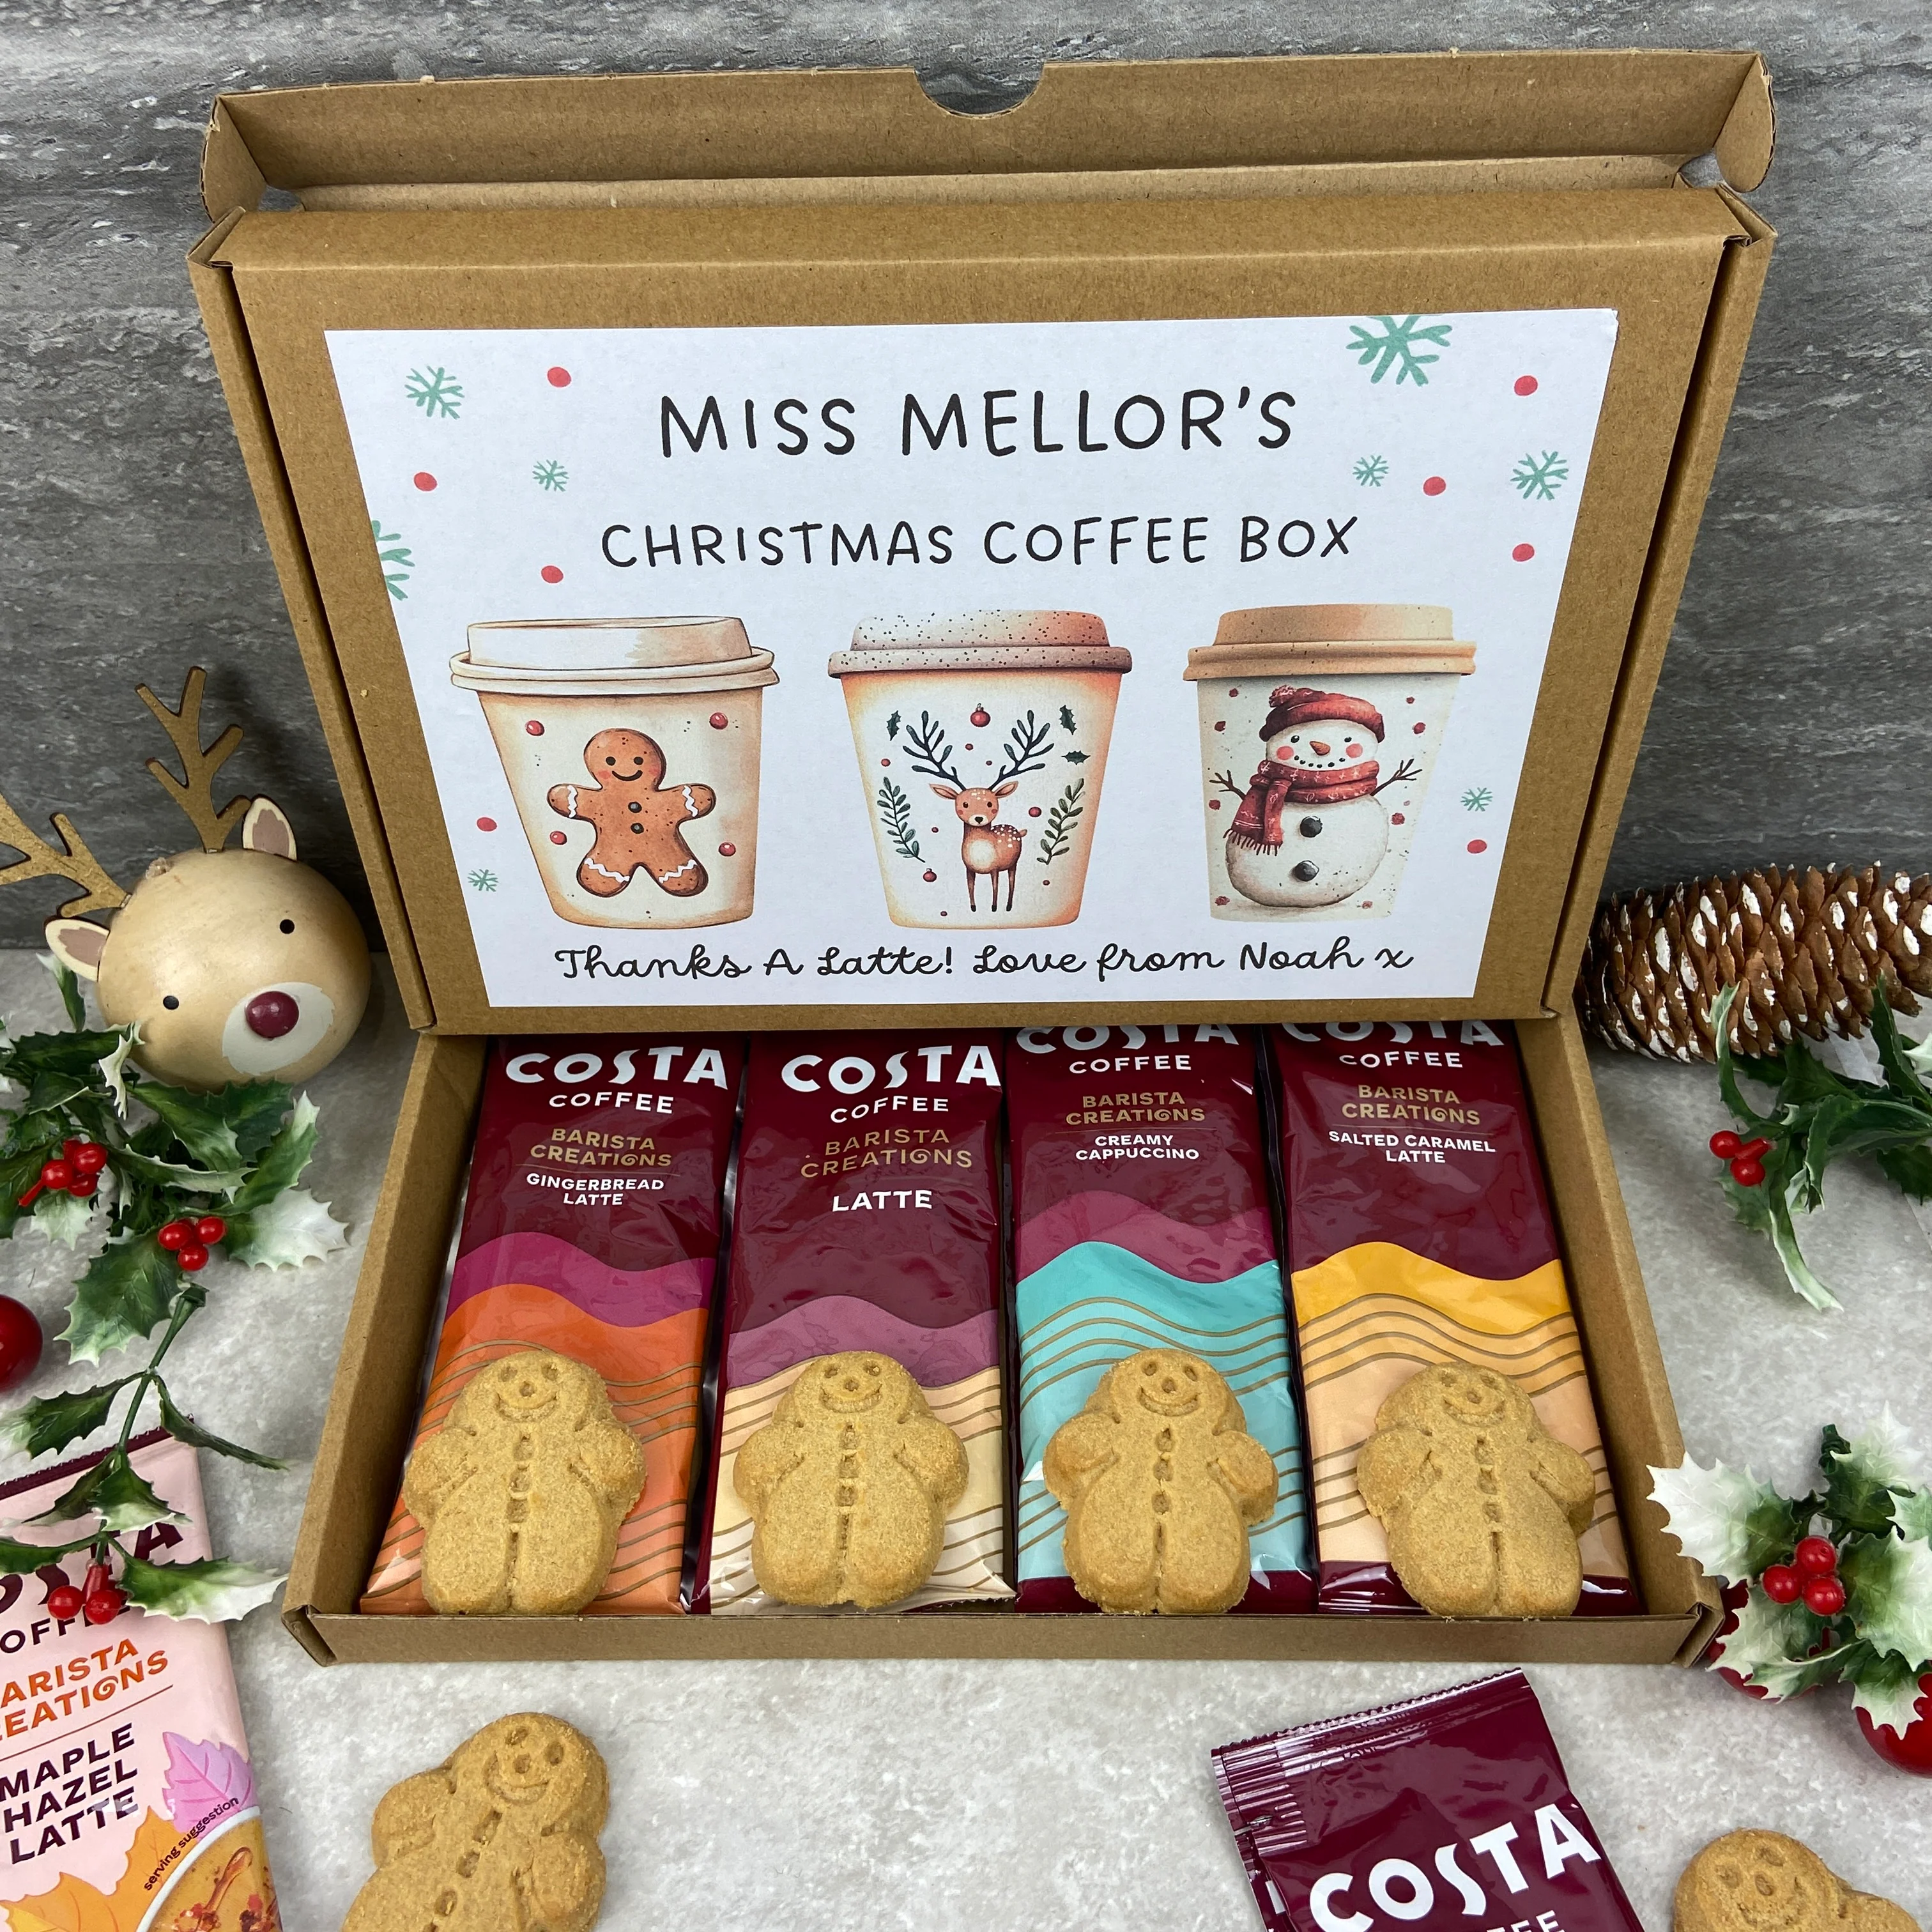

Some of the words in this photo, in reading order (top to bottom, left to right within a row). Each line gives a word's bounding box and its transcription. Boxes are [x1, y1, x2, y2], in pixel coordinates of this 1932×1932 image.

[661, 396, 854, 457] MISS
[903, 387, 1295, 456] MELLOR'S
[602, 521, 953, 567] CHRISTMAS
[985, 516, 1208, 565] COFFEE
[1241, 516, 1357, 562] BOX
[555, 944, 752, 979] Thanks
[763, 949, 804, 976] A
[817, 946, 952, 975] Latte!
[973, 945, 1087, 974] Love
[1097, 944, 1225, 982] from
[1240, 936, 1364, 970] Noah
[507, 1047, 727, 1089] COSTA
[782, 1046, 1000, 1094] COSTA
[1070, 1055, 1191, 1073] COFFEE
[1340, 1052, 1462, 1068] COFFEE
[549, 1092, 673, 1114] COFFEE
[1083, 1092, 1184, 1108] BARISTA
[1358, 1085, 1459, 1104] BARISTA
[831, 1096, 948, 1123] COFFEE
[1066, 1108, 1205, 1124] CREATIONS
[1342, 1103, 1480, 1125] CREATIONS
[551, 1129, 655, 1150] BARISTA
[825, 1129, 950, 1156] BARISTA
[1095, 1135, 1174, 1146] CREAMY
[1329, 1131, 1399, 1147] SALTED
[1404, 1135, 1496, 1152] CARAMEL
[531, 1144, 671, 1166] CREATIONS
[801, 1149, 972, 1177] CREATIONS
[1076, 1148, 1199, 1160] CAPPUCCINO
[1386, 1151, 1445, 1163] LATTE
[527, 1174, 663, 1190] GINGERBREAD
[564, 1193, 623, 1206] LATTE
[832, 1190, 932, 1211] LATTE
[0, 1638, 138, 1709] ARISTA
[0, 1722, 135, 1802] MAPLE
[3, 1759, 138, 1833] HAZEL
[10, 1786, 139, 1865] LATTE
[144, 1846, 181, 1890] serving
[178, 1797, 239, 1848] suggestion
[1310, 1804, 1601, 1932] COSTA
